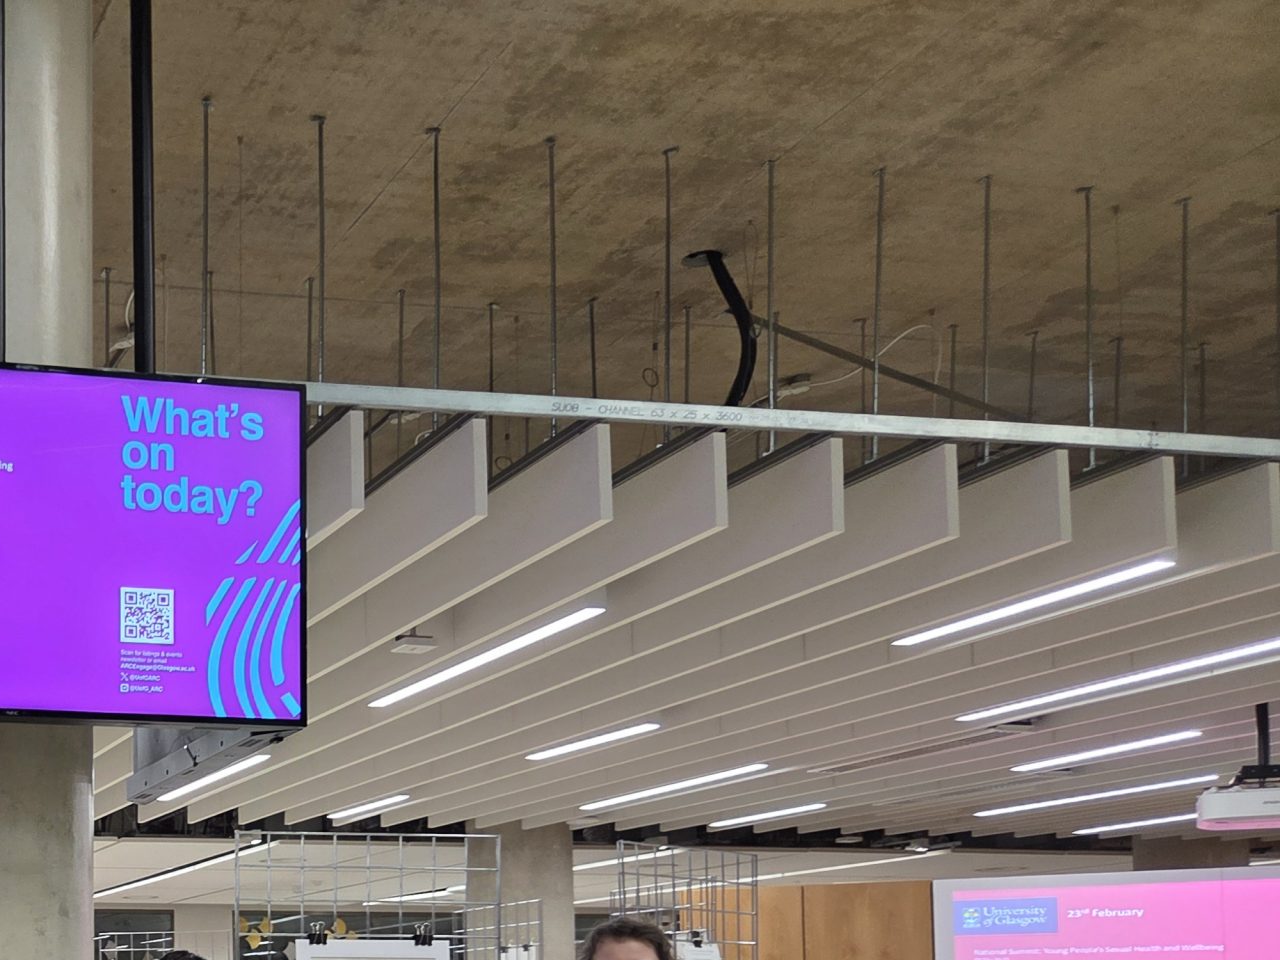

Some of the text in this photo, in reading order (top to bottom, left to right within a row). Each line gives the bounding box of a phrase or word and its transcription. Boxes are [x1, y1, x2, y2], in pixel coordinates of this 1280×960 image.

[121, 438, 175, 472] on
[121, 473, 264, 525] today?
[983, 905, 1048, 917] University
[1092, 908, 1144, 918] February
[994, 915, 1048, 927] Glasgow
